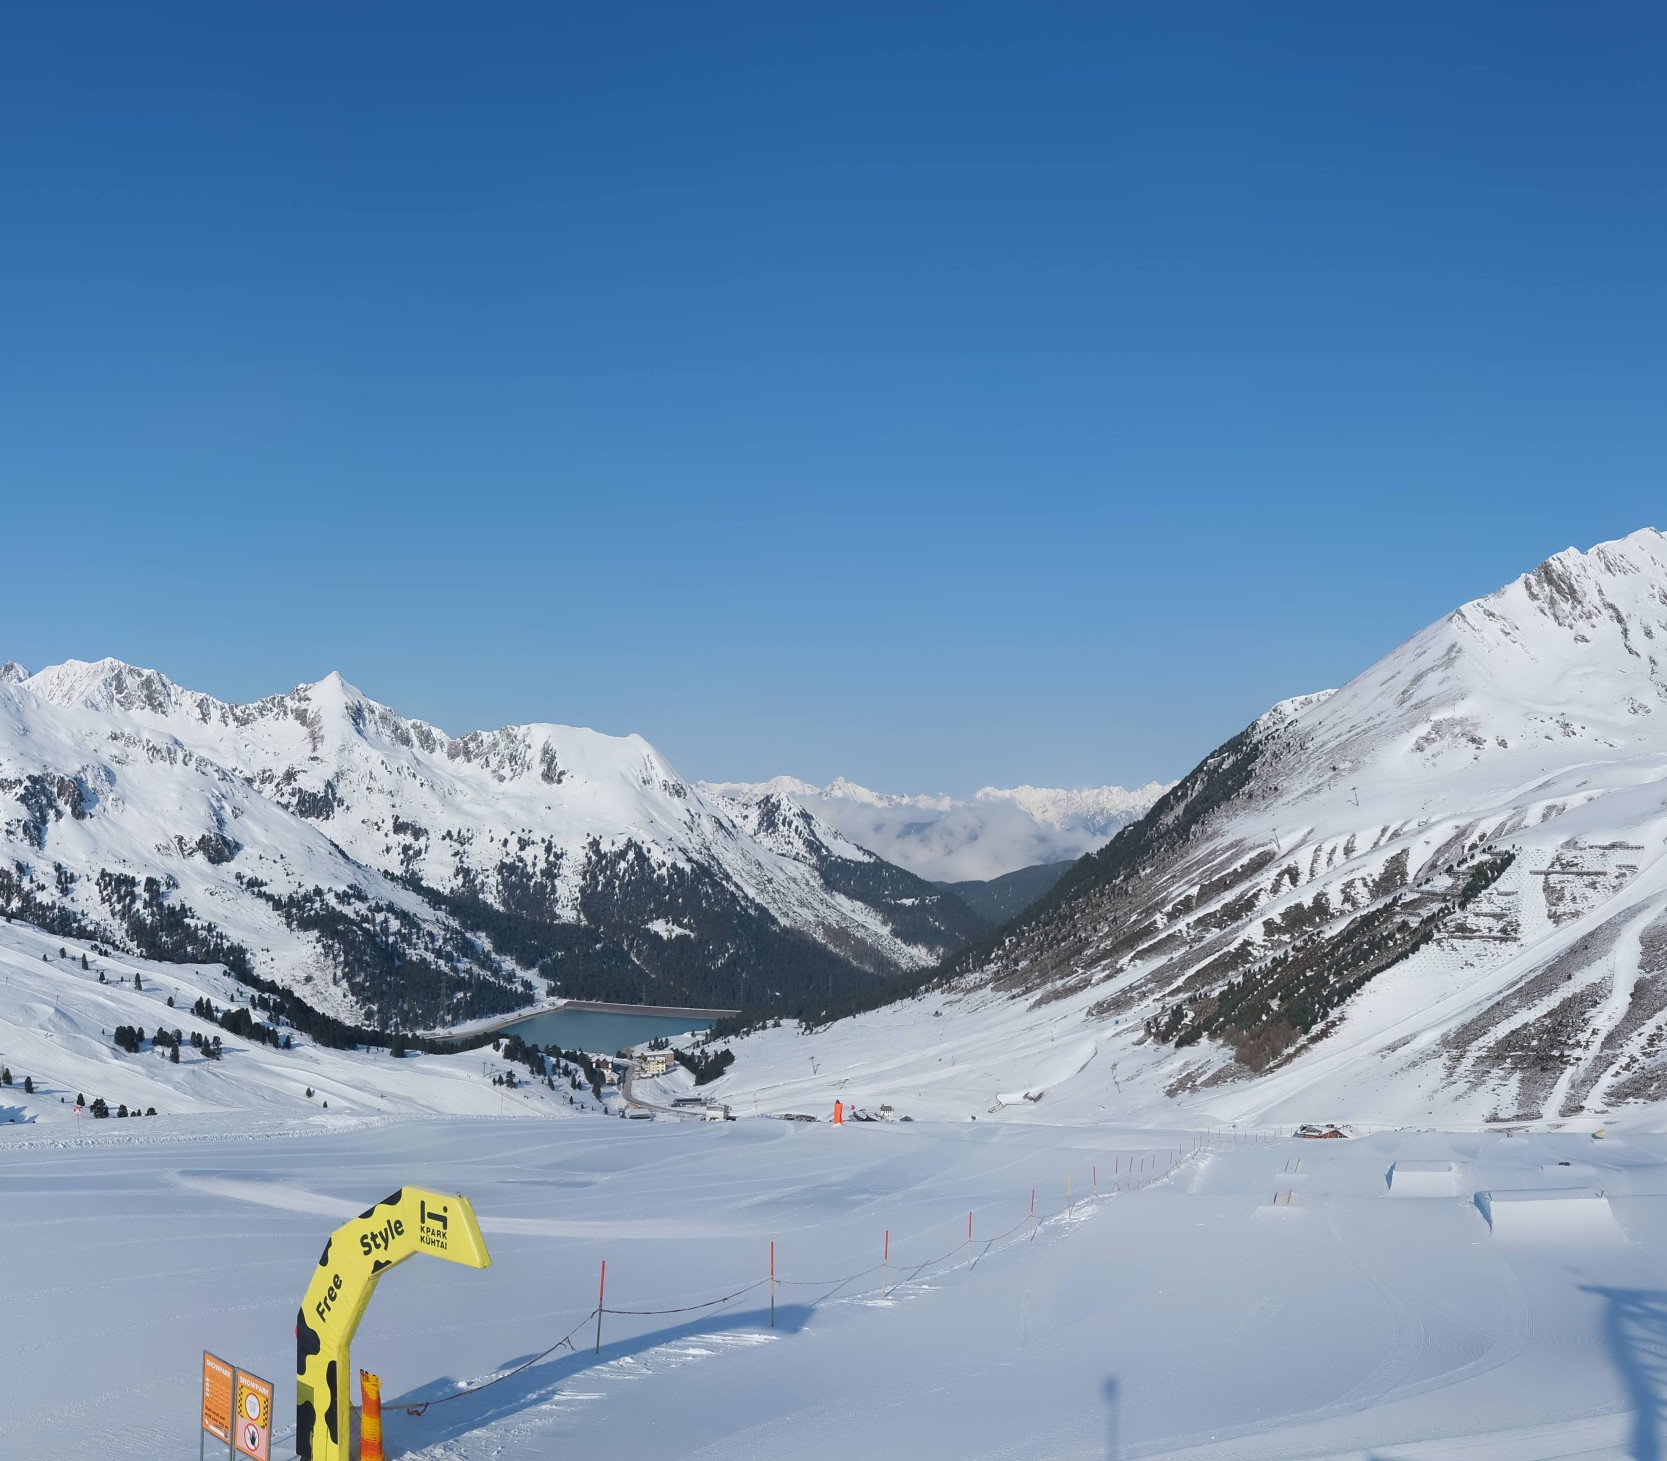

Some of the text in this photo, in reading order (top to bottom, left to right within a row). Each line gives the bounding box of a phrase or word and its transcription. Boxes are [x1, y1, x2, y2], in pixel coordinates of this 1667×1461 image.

[316, 1219, 404, 1323] Free Style
[206, 1359, 231, 1378] SNOWPARK
[239, 1376, 269, 1396] SNOWPARK
